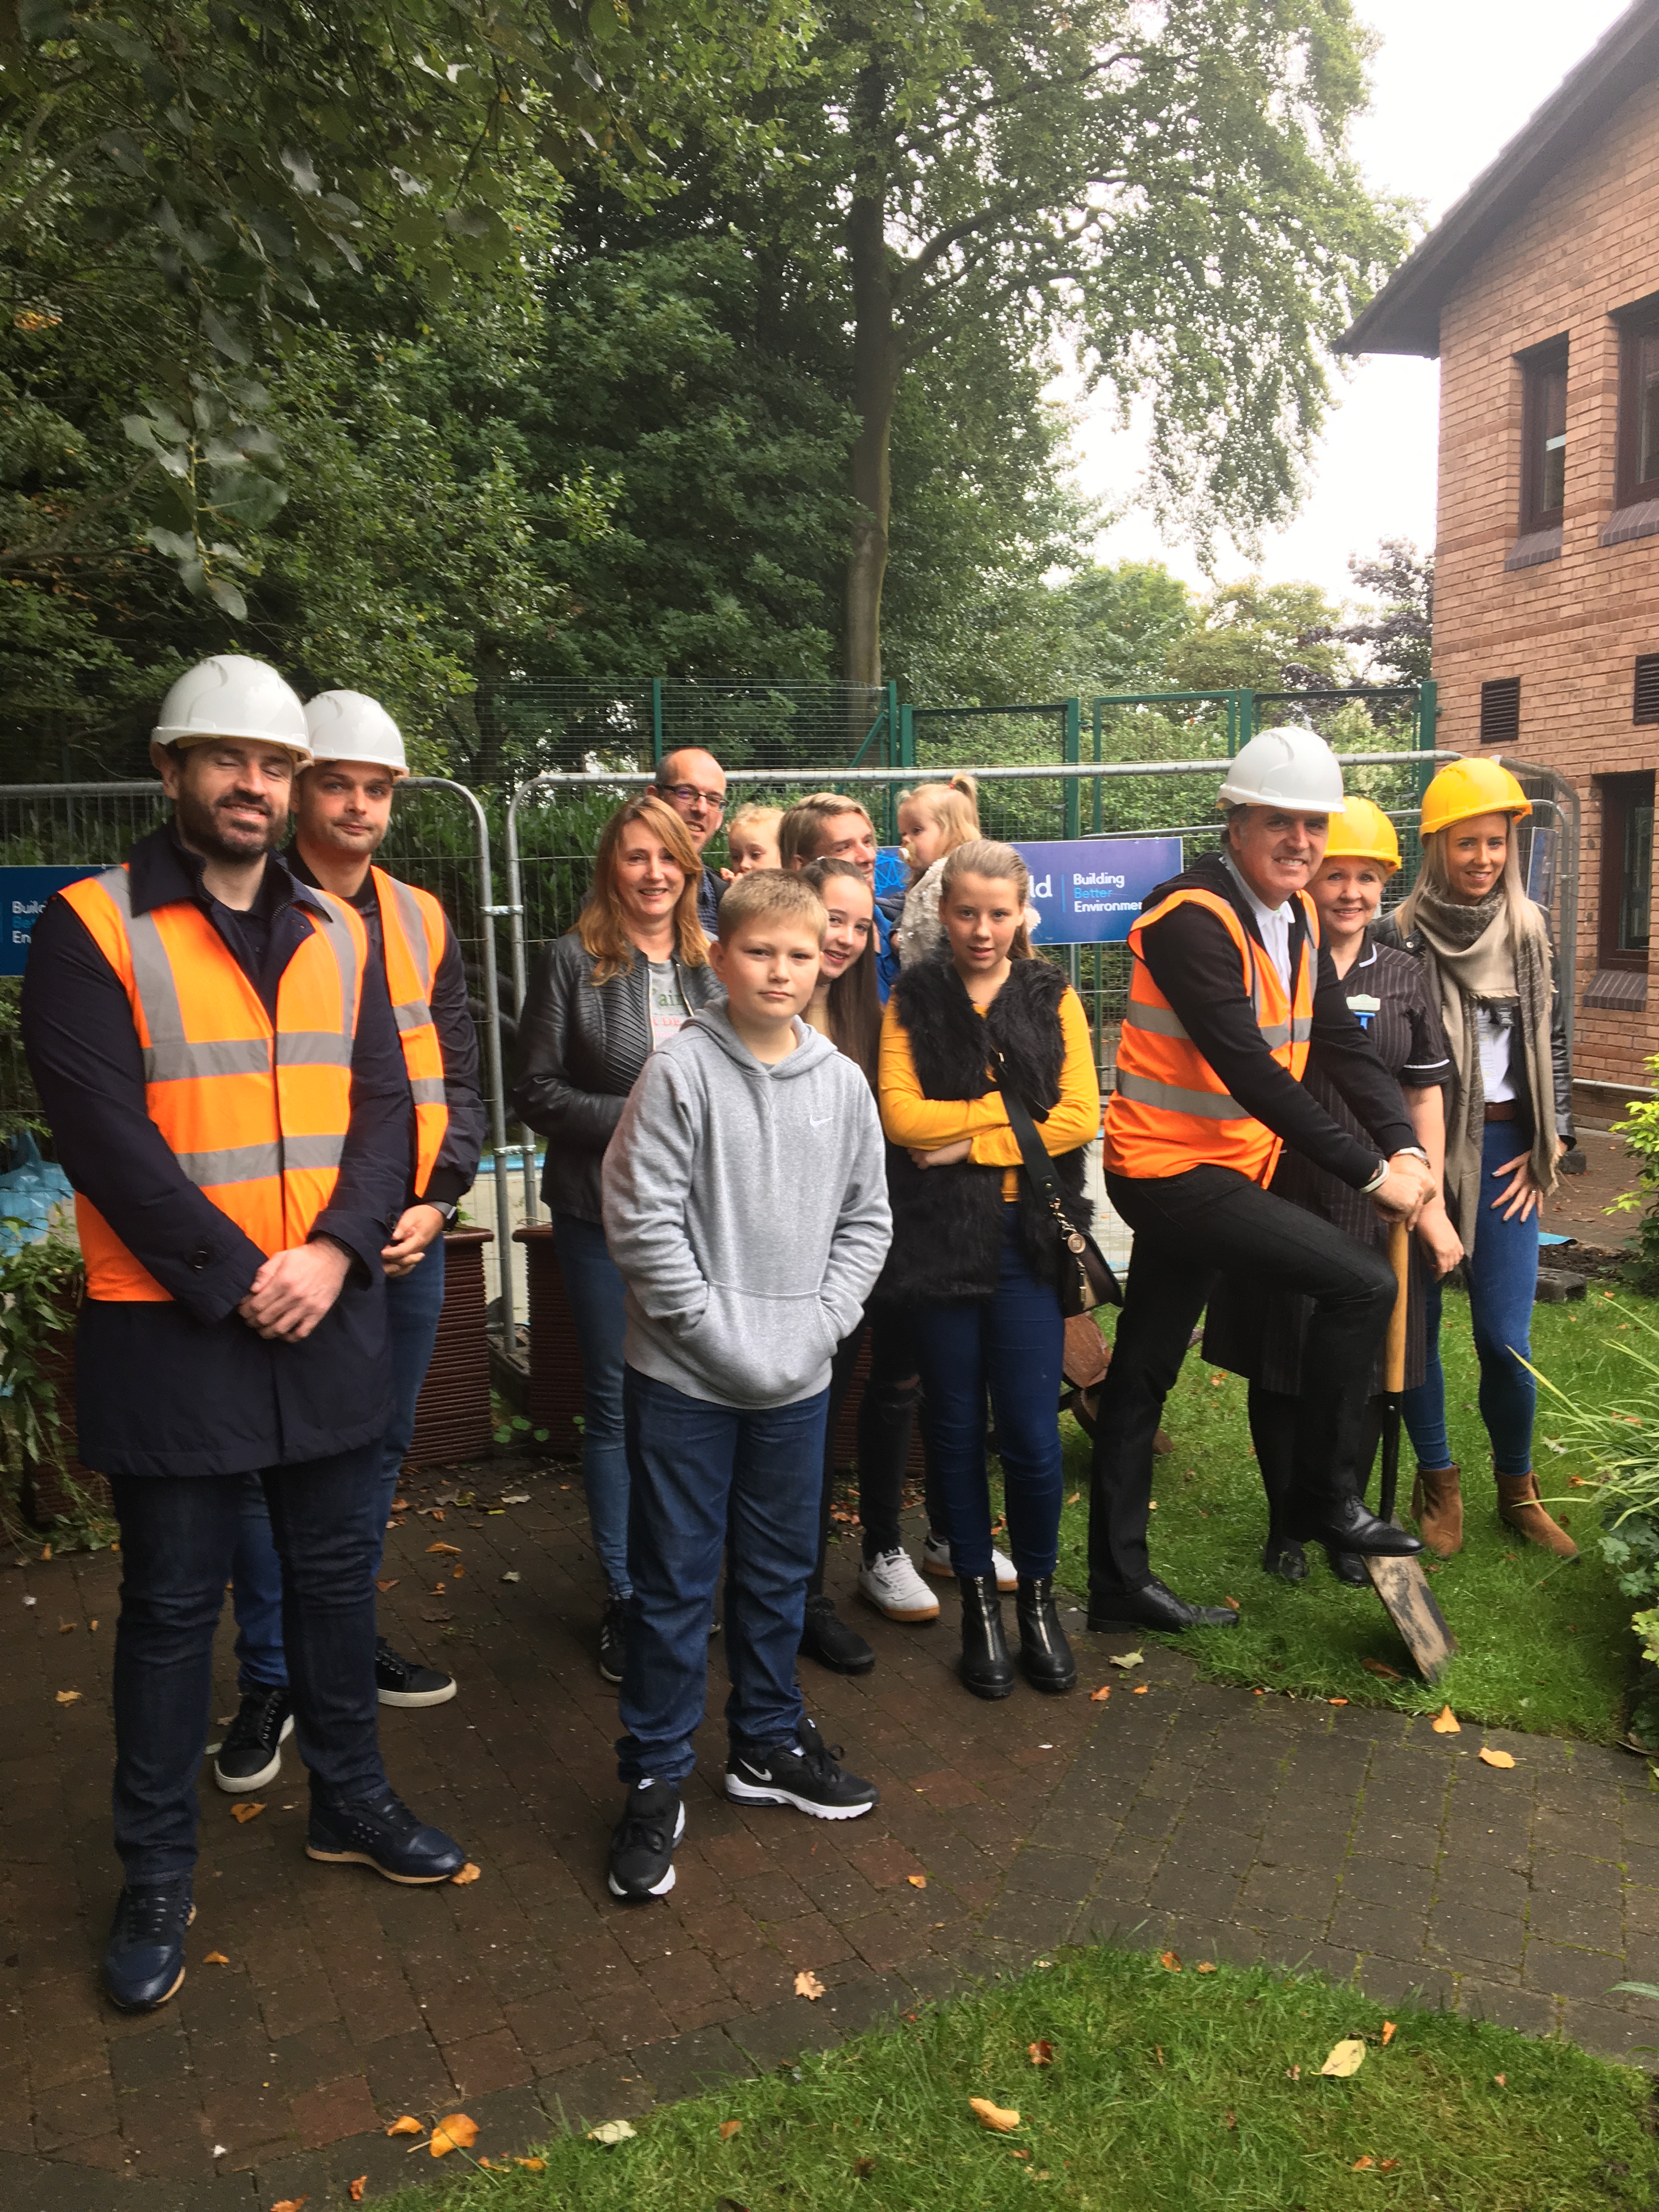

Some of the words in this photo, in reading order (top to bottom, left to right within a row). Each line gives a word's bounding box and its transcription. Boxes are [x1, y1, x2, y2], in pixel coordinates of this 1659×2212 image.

[1073, 872, 1125, 888] Building
[1074, 887, 1113, 899] Better
[12, 930, 31, 943] En
